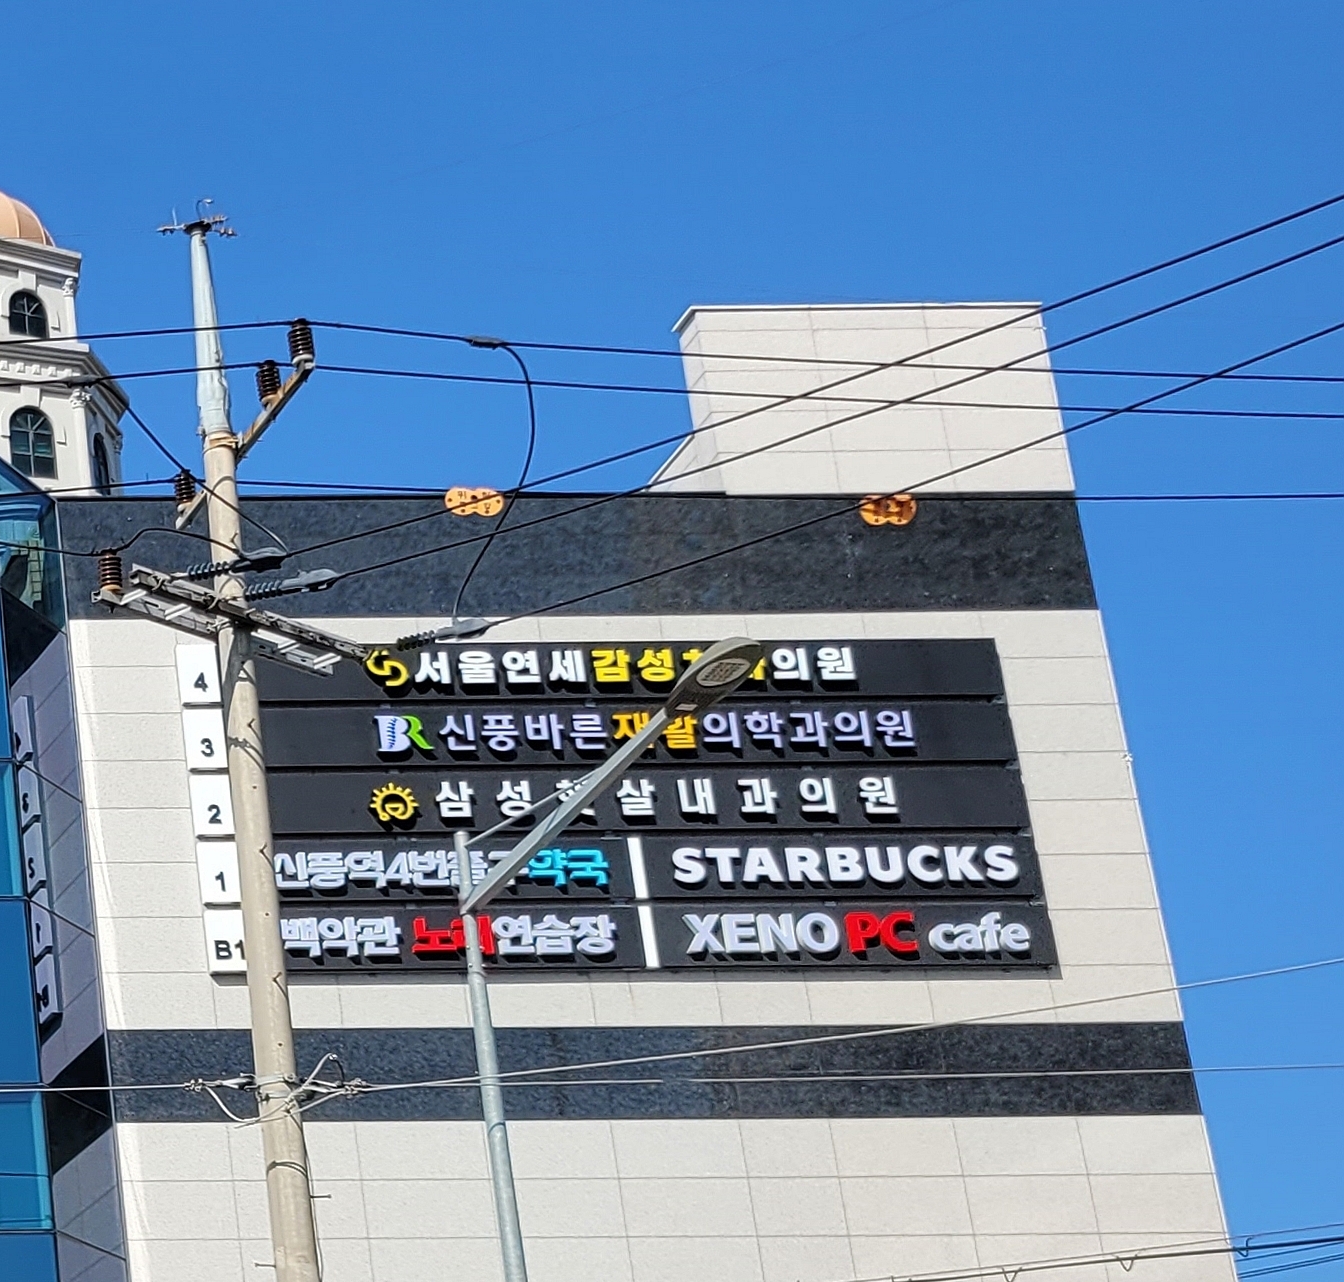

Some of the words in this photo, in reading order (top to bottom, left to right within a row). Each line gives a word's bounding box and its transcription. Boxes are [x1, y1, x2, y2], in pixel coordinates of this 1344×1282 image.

[193, 672, 209, 693] 4
[414, 646, 858, 686] 서울연세감성의원
[200, 738, 215, 757] 3
[439, 709, 917, 752] 신풍바른재활의학과의원
[207, 803, 221, 824] 2
[214, 871, 227, 893] 1
[672, 845, 1020, 884] STARBUCKS
[280, 915, 402, 958] 백악관
[682, 913, 840, 954] XENO
[844, 911, 918, 953] PC
[928, 911, 1032, 952] cafe
